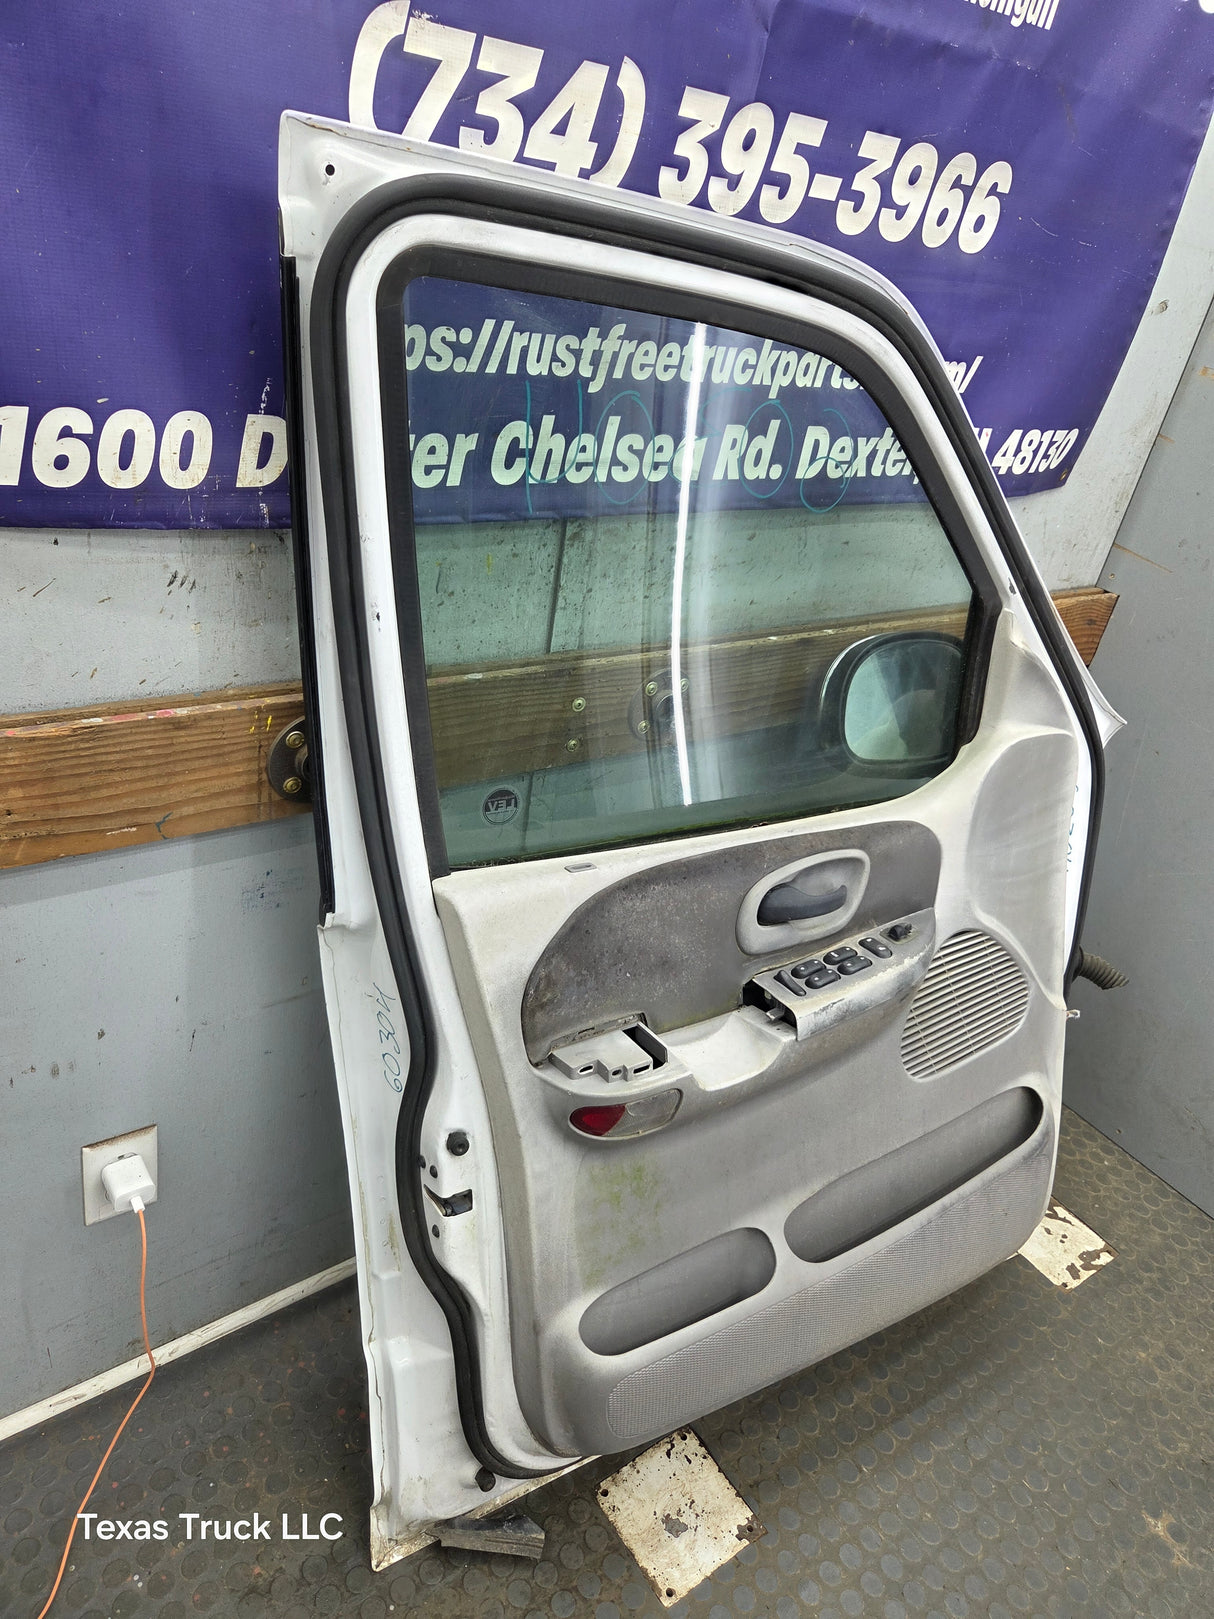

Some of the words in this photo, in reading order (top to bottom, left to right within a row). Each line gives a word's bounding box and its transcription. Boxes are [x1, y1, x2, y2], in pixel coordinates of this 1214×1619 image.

[658, 86, 1013, 254] 395-3966
[490, 415, 707, 486] Chelsea
[712, 419, 783, 481] Rd.
[991, 428, 1079, 475] 48130
